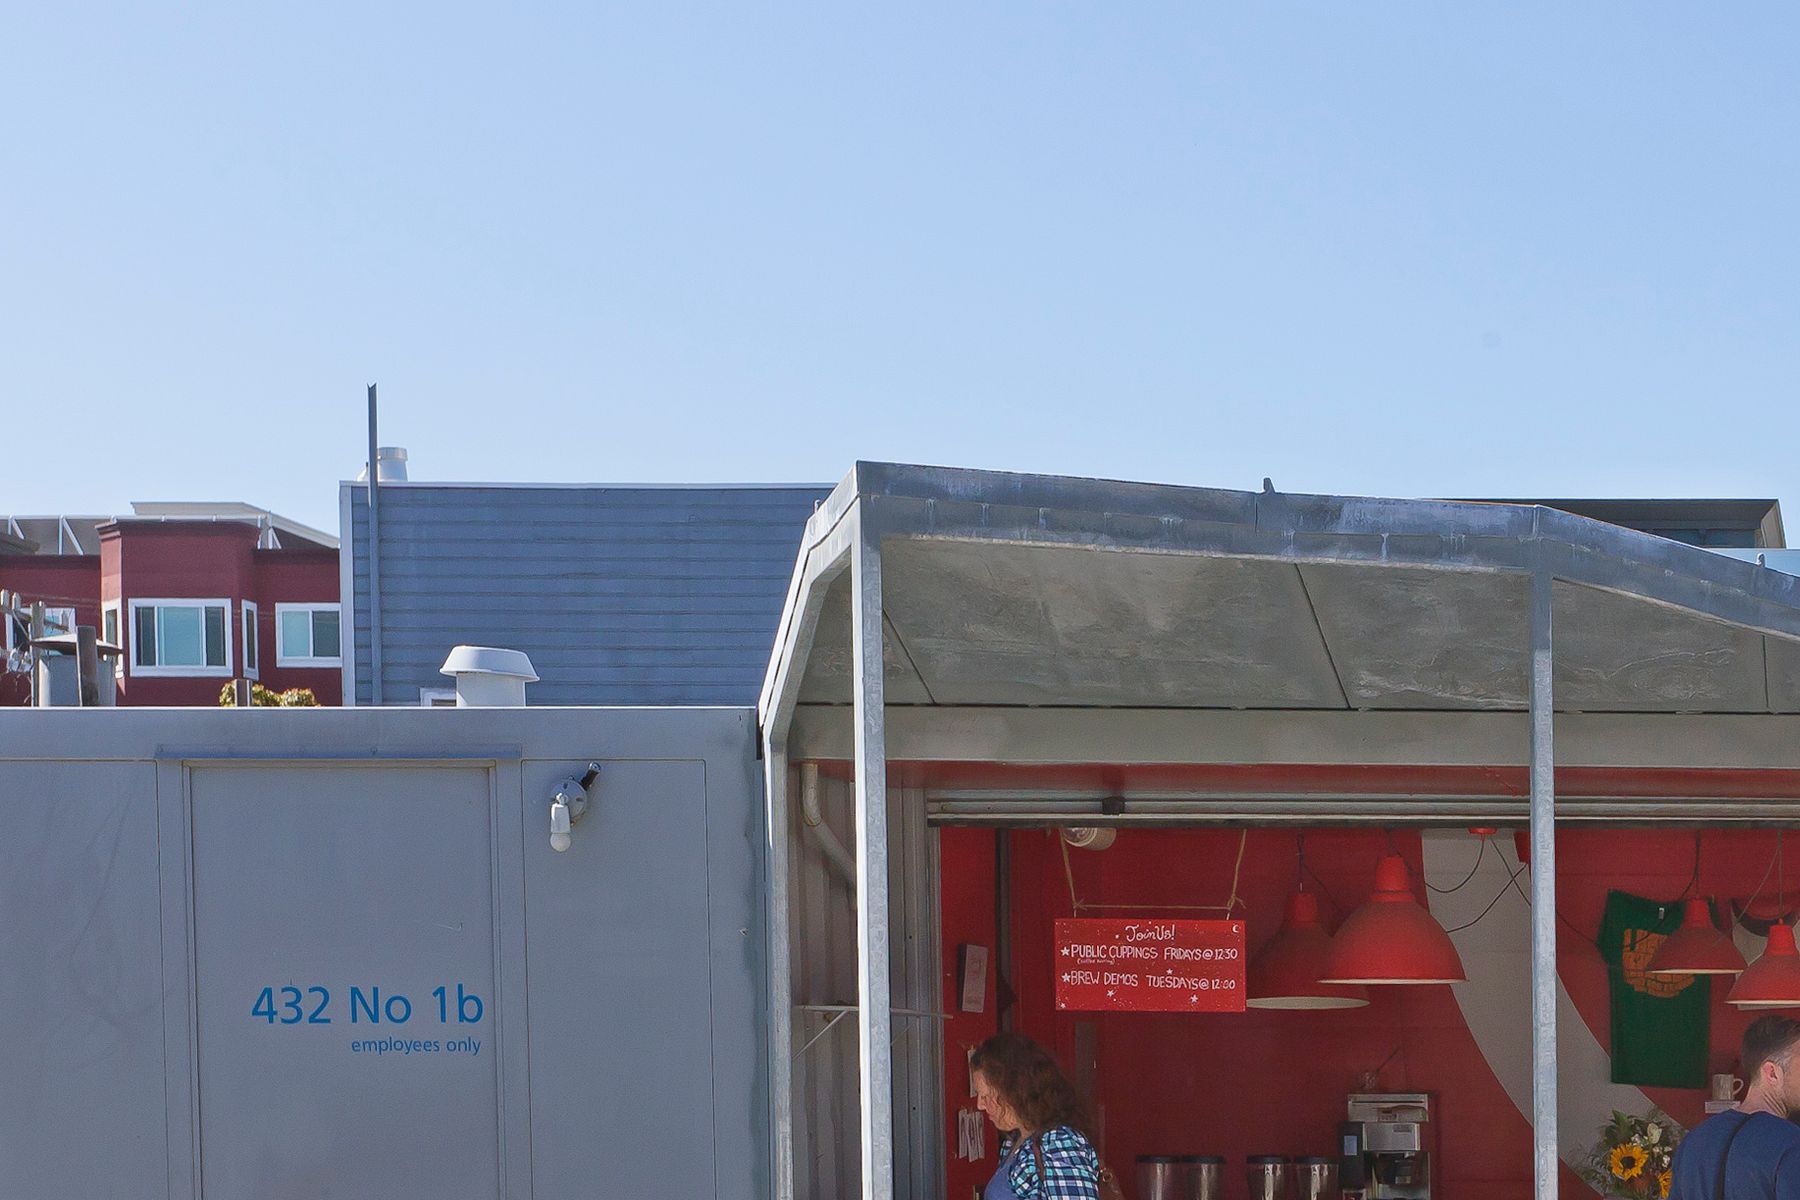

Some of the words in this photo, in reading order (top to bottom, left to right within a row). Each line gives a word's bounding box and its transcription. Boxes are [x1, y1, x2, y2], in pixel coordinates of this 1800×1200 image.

[1125, 925, 1155, 942] Join
[1155, 924, 1176, 941] Us!
[1071, 944, 1107, 958] PUBLIC
[1108, 945, 1158, 960] CUPPINGS
[1070, 970, 1100, 985] BREW
[1104, 972, 1139, 987] DEMOS
[251, 985, 332, 1025] 432
[350, 985, 412, 1024] No
[431, 983, 484, 1024] 1b
[351, 1036, 440, 1055] employees
[446, 1036, 482, 1055] only
